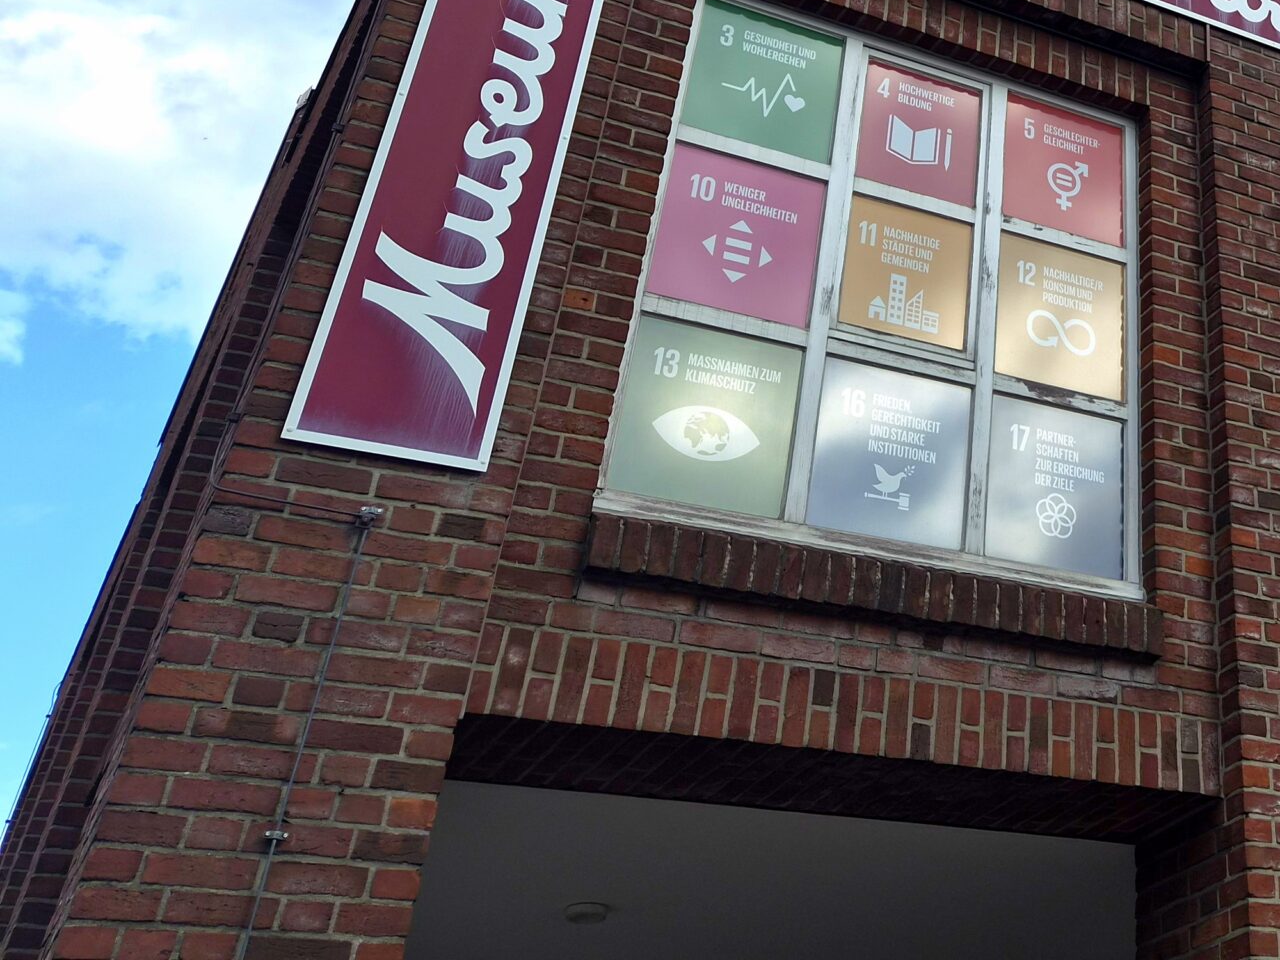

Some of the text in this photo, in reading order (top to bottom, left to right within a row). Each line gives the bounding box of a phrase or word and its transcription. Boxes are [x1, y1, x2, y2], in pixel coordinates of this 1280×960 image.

[720, 24, 735, 46] 3
[744, 30, 816, 60] GESUNDHEIT UND
[742, 42, 806, 69] WOHLERGEHEN
[877, 78, 890, 98] 4
[899, 82, 956, 108] HOCHWERTIGE
[898, 94, 932, 111] BILDUNG
[1024, 117, 1035, 139] 5
[1044, 123, 1100, 148] GESCHLECHTER-
[1043, 134, 1084, 155] GLEICHHEIT
[690, 173, 716, 202] 10
[724, 181, 766, 202] WENIGER
[721, 194, 798, 224] UNGLEICHHEITEN
[859, 221, 878, 247] 11
[883, 226, 940, 250] NACHHALTIGE
[881, 252, 930, 273] GEMEINDEN
[915, 247, 933, 261] UND
[1017, 260, 1036, 286] 12
[1043, 266, 1104, 291] NACHHALTIGE/R
[1043, 279, 1093, 300] KONSUM UND
[1043, 292, 1093, 313] PRODUKTION
[654, 347, 680, 378] 13
[688, 353, 781, 384] MASSNAHMEN ZUM
[685, 368, 756, 394] KLIMASCHUTZ
[840, 387, 866, 418] 16
[872, 393, 913, 414] FRIEDEN,
[872, 408, 941, 434] GERECHTIGKEIT
[870, 424, 925, 447] UND STARKE
[1010, 423, 1030, 452] 17
[1036, 428, 1077, 447] PARTNER-
[868, 439, 937, 464] INSTITUTIONEN
[1036, 443, 1079, 463] SCHAFTEN
[1034, 473, 1075, 492] DER ZIELE
[1035, 458, 1105, 483] ZUR ERREICHUNG
